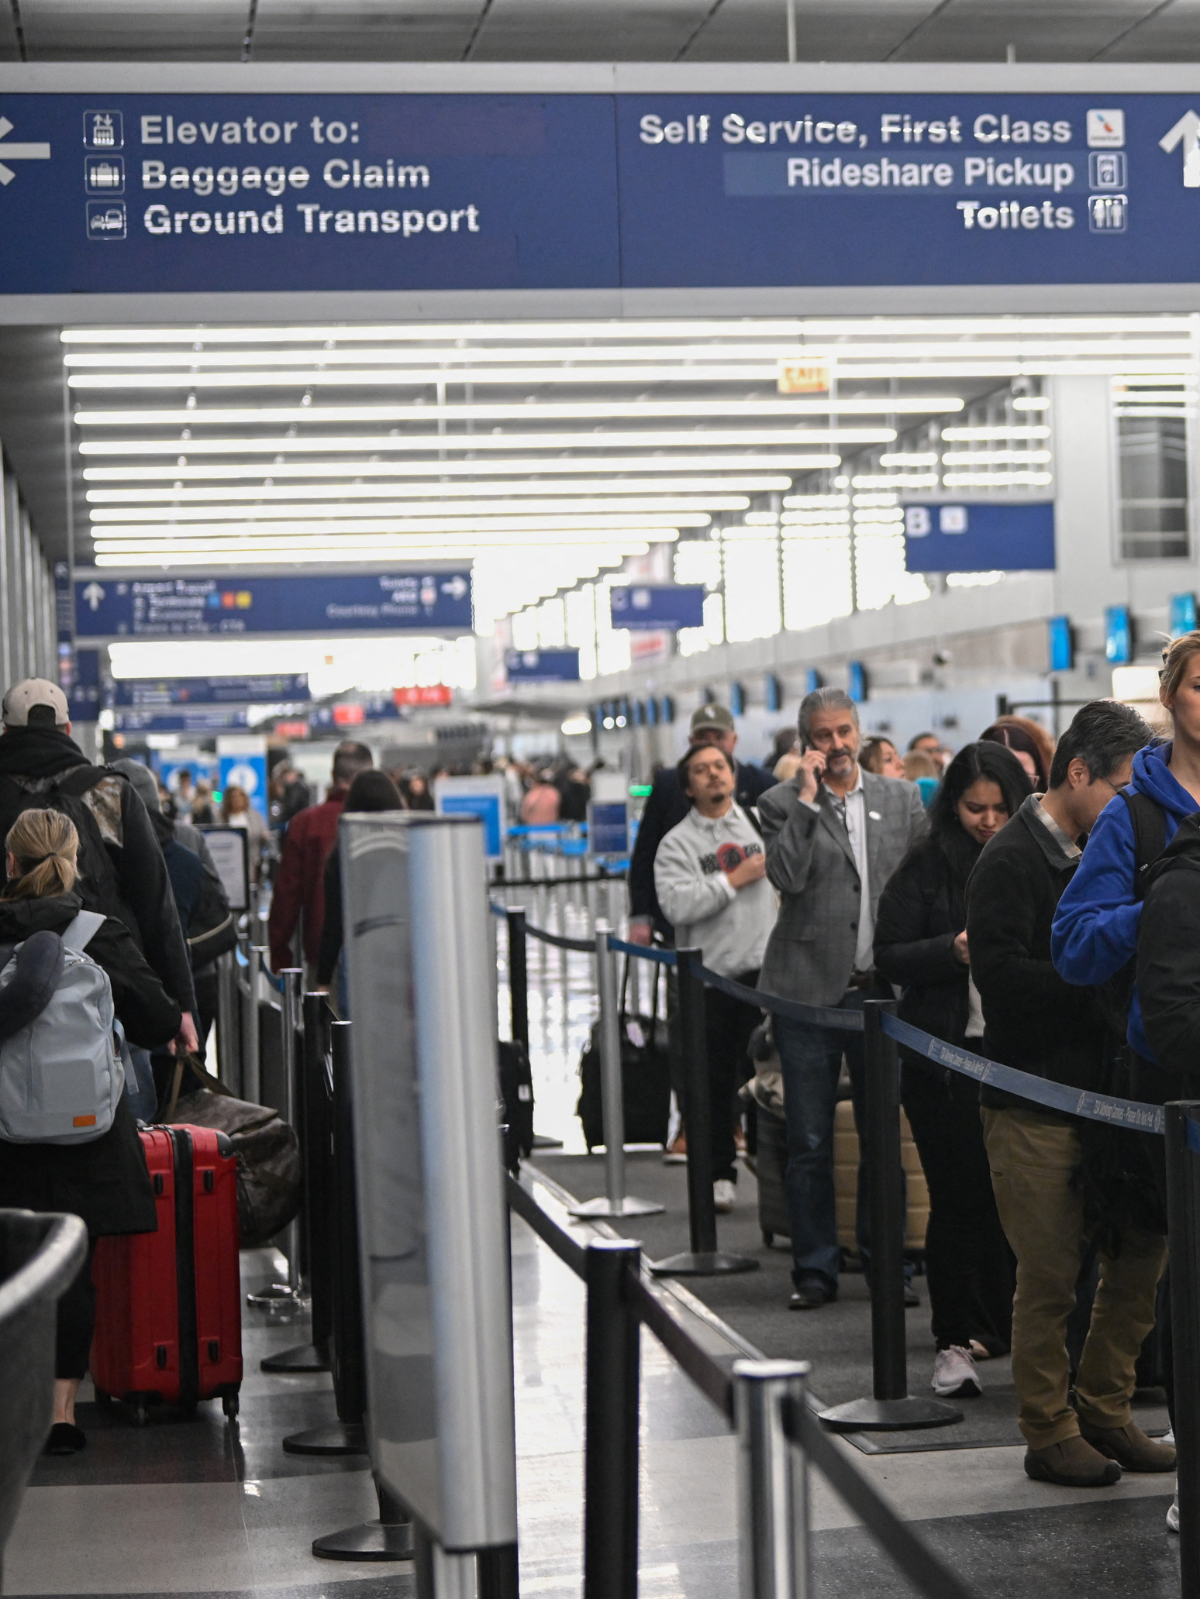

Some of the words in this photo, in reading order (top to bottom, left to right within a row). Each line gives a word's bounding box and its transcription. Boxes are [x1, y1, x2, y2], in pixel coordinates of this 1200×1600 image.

[141, 116, 298, 144] Elevator
[310, 116, 360, 144] to:
[642, 113, 711, 145] Self
[721, 113, 867, 148] Service,
[881, 113, 962, 143] First
[973, 113, 1072, 143] Class
[141, 160, 310, 196] Baggage
[323, 159, 431, 188] Claim
[787, 157, 954, 187] Rideshare
[964, 157, 1075, 193] Pickup
[143, 204, 284, 235] Ground
[297, 203, 480, 238] Transport
[955, 200, 1075, 230] Toilets
[905, 506, 931, 538] B
